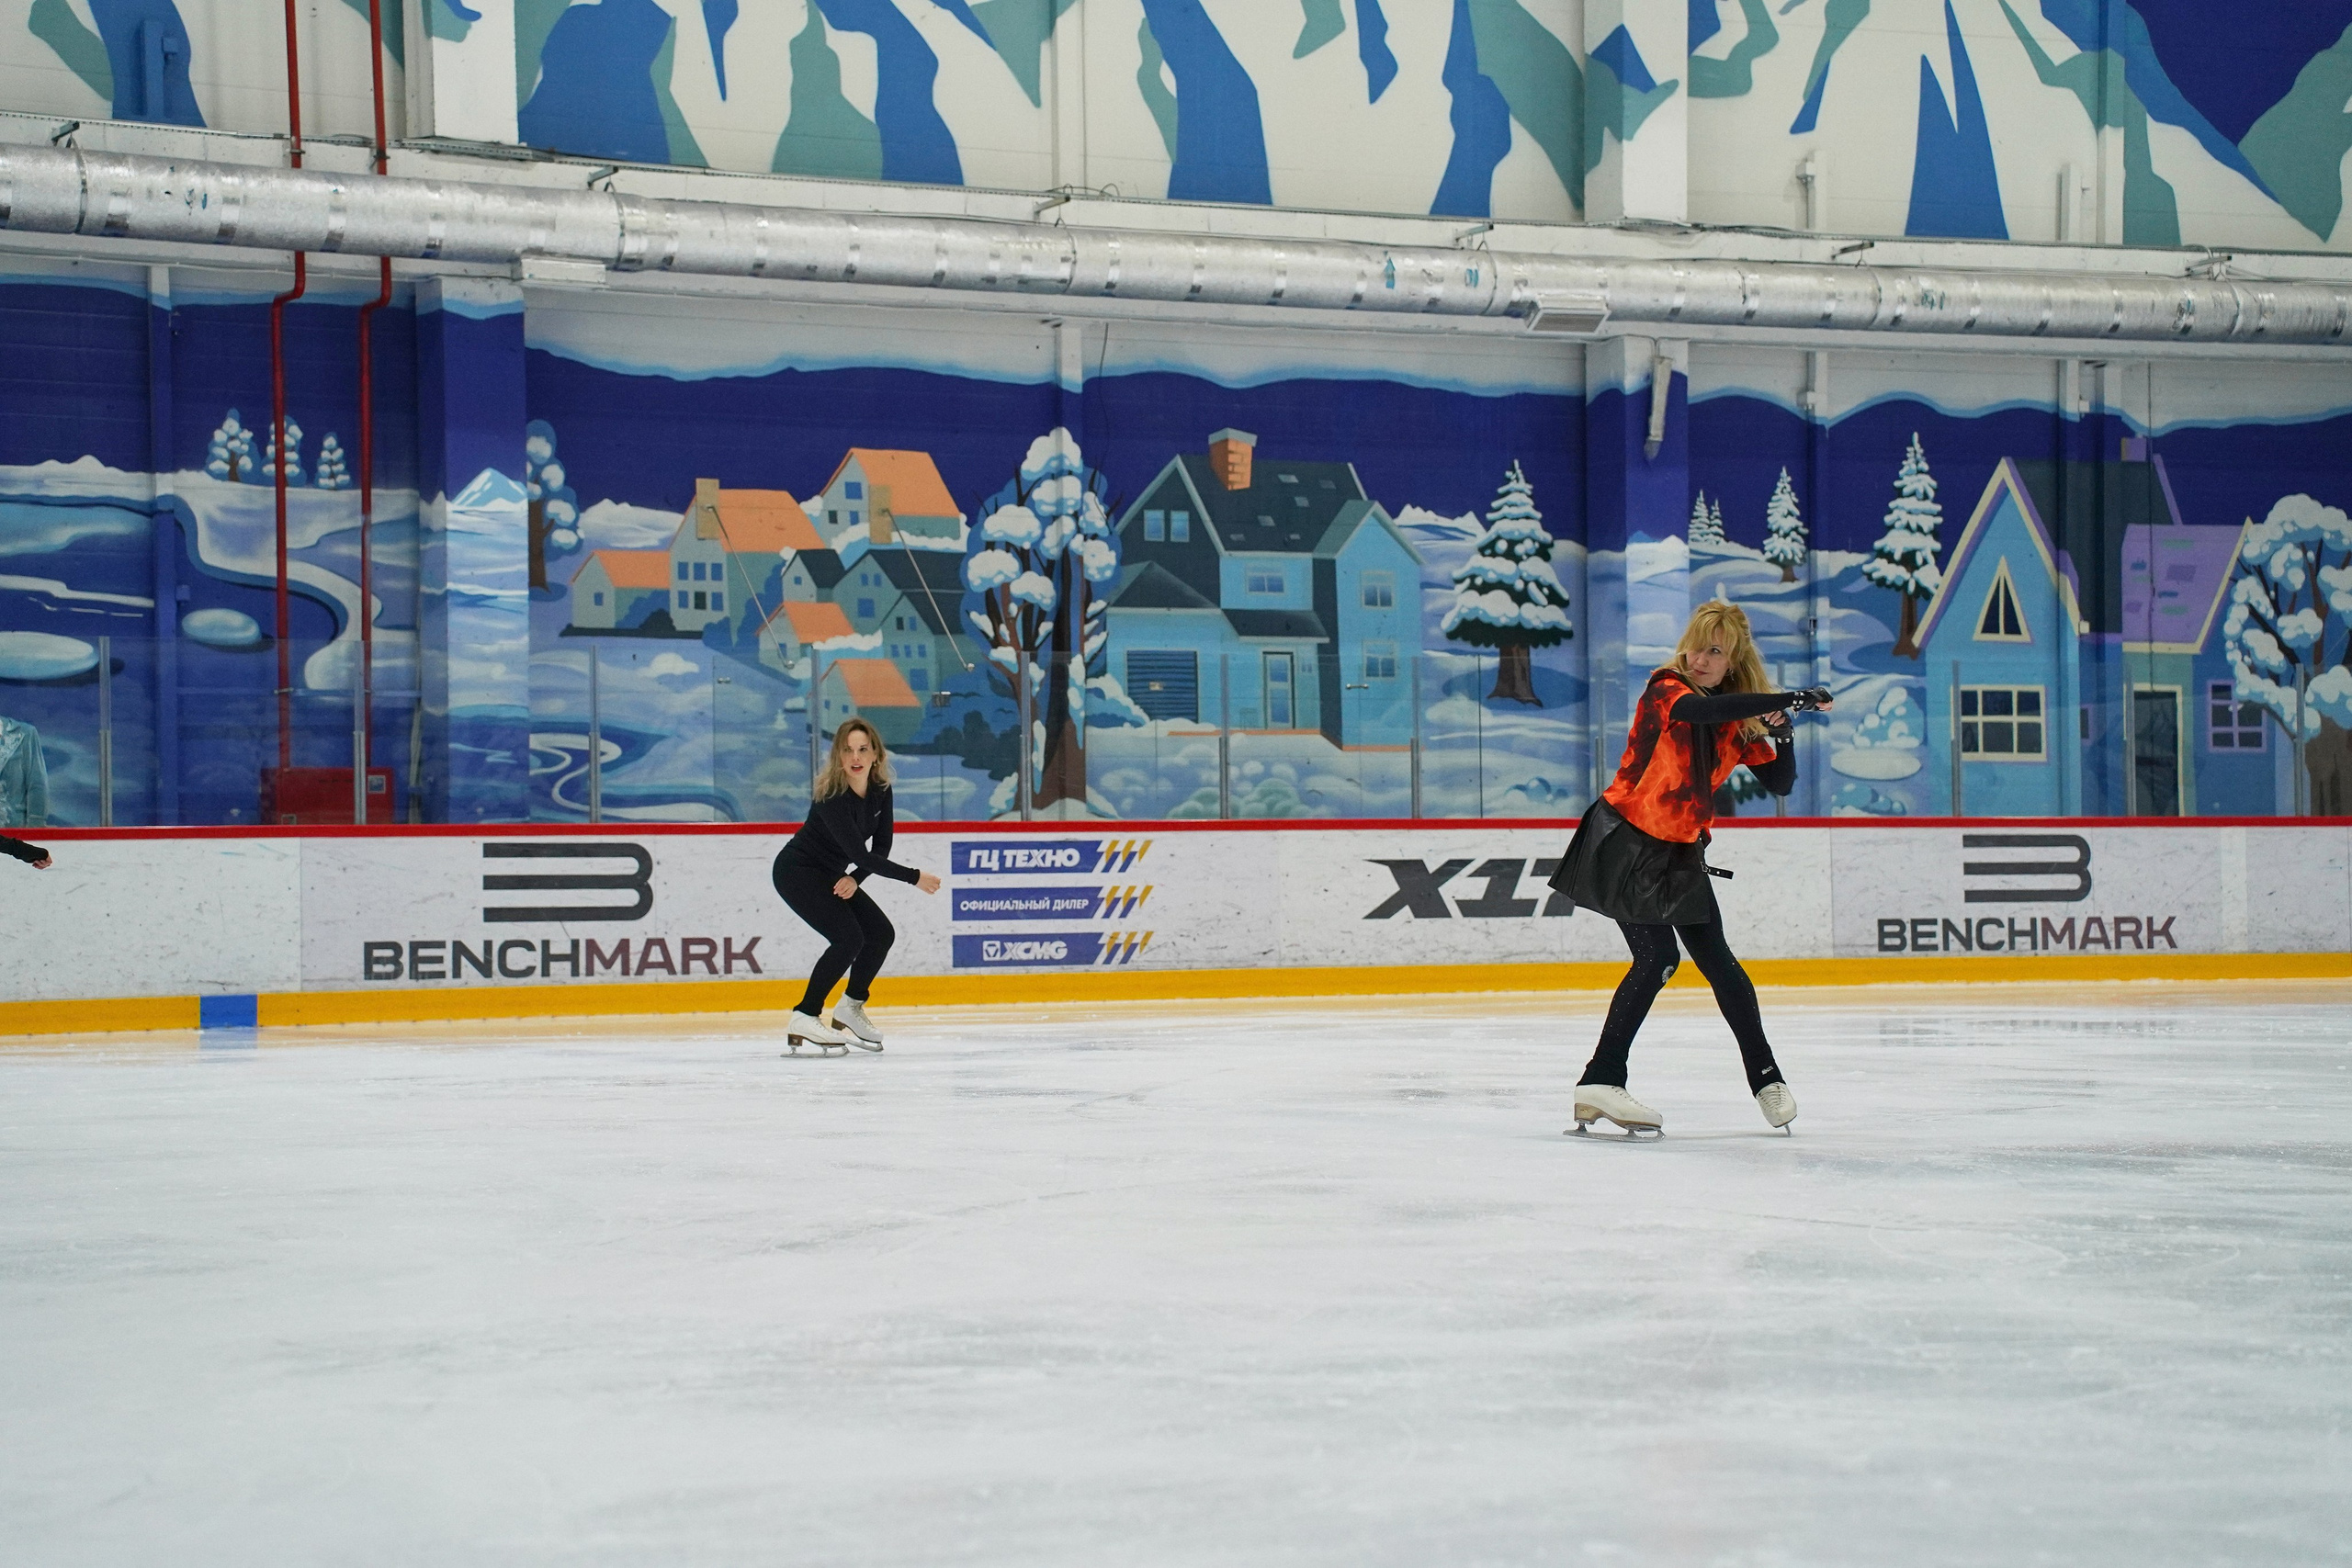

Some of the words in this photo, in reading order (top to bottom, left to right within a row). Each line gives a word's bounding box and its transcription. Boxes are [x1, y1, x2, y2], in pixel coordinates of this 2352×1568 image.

[969, 849, 1000, 871] ГЦ
[1002, 848, 1080, 868] ТЕХНО
[960, 897, 1050, 912] ОФИЦИАЛЬНЫЙ
[1052, 898, 1089, 912] ДИЛЕР
[1877, 916, 2178, 953] BENCHMARK
[363, 936, 763, 981] BENCHMARK
[1003, 940, 1068, 961] XCMG
